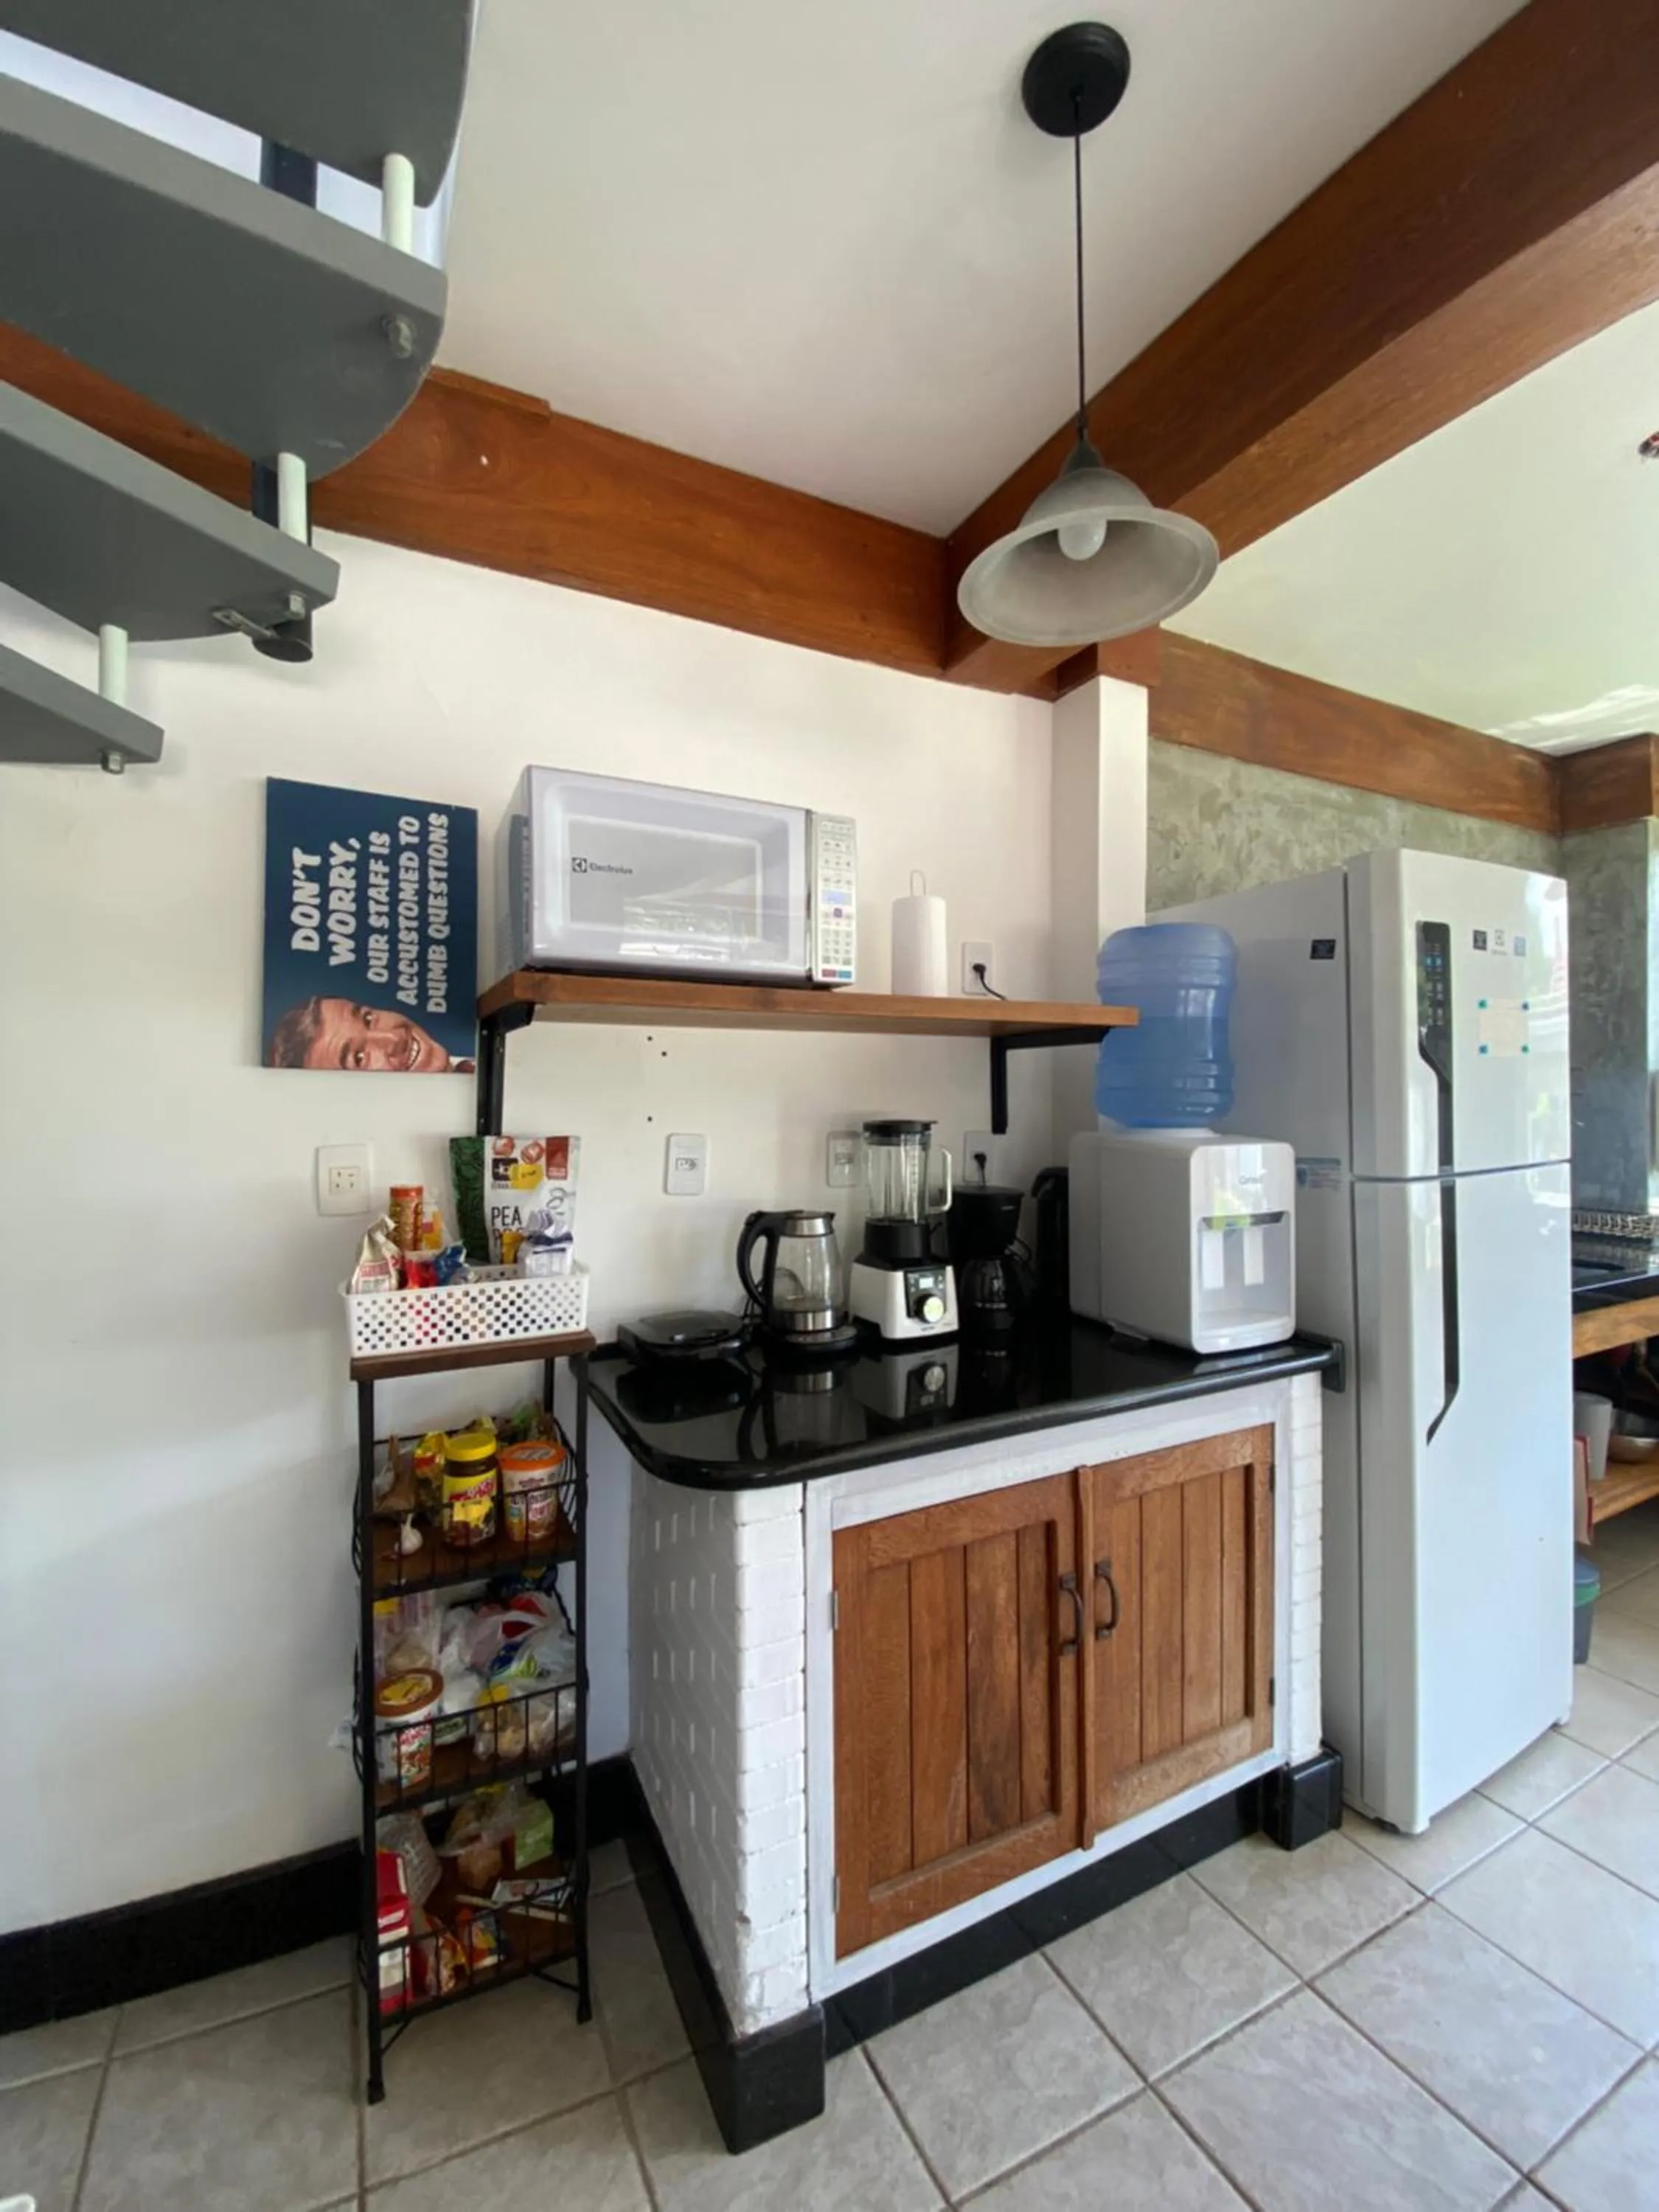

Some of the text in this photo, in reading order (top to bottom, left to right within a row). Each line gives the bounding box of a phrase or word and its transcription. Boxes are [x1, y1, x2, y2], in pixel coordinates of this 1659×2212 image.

[291, 846, 322, 953] DON'T
[326, 837, 362, 967] WORRY,
[366, 831, 392, 984] OUR STAFF IS
[396, 815, 420, 1006] ACCUSTOMED TO
[427, 813, 451, 1013] DUMB QUESTIONS
[490, 1206, 523, 1227] PEA
